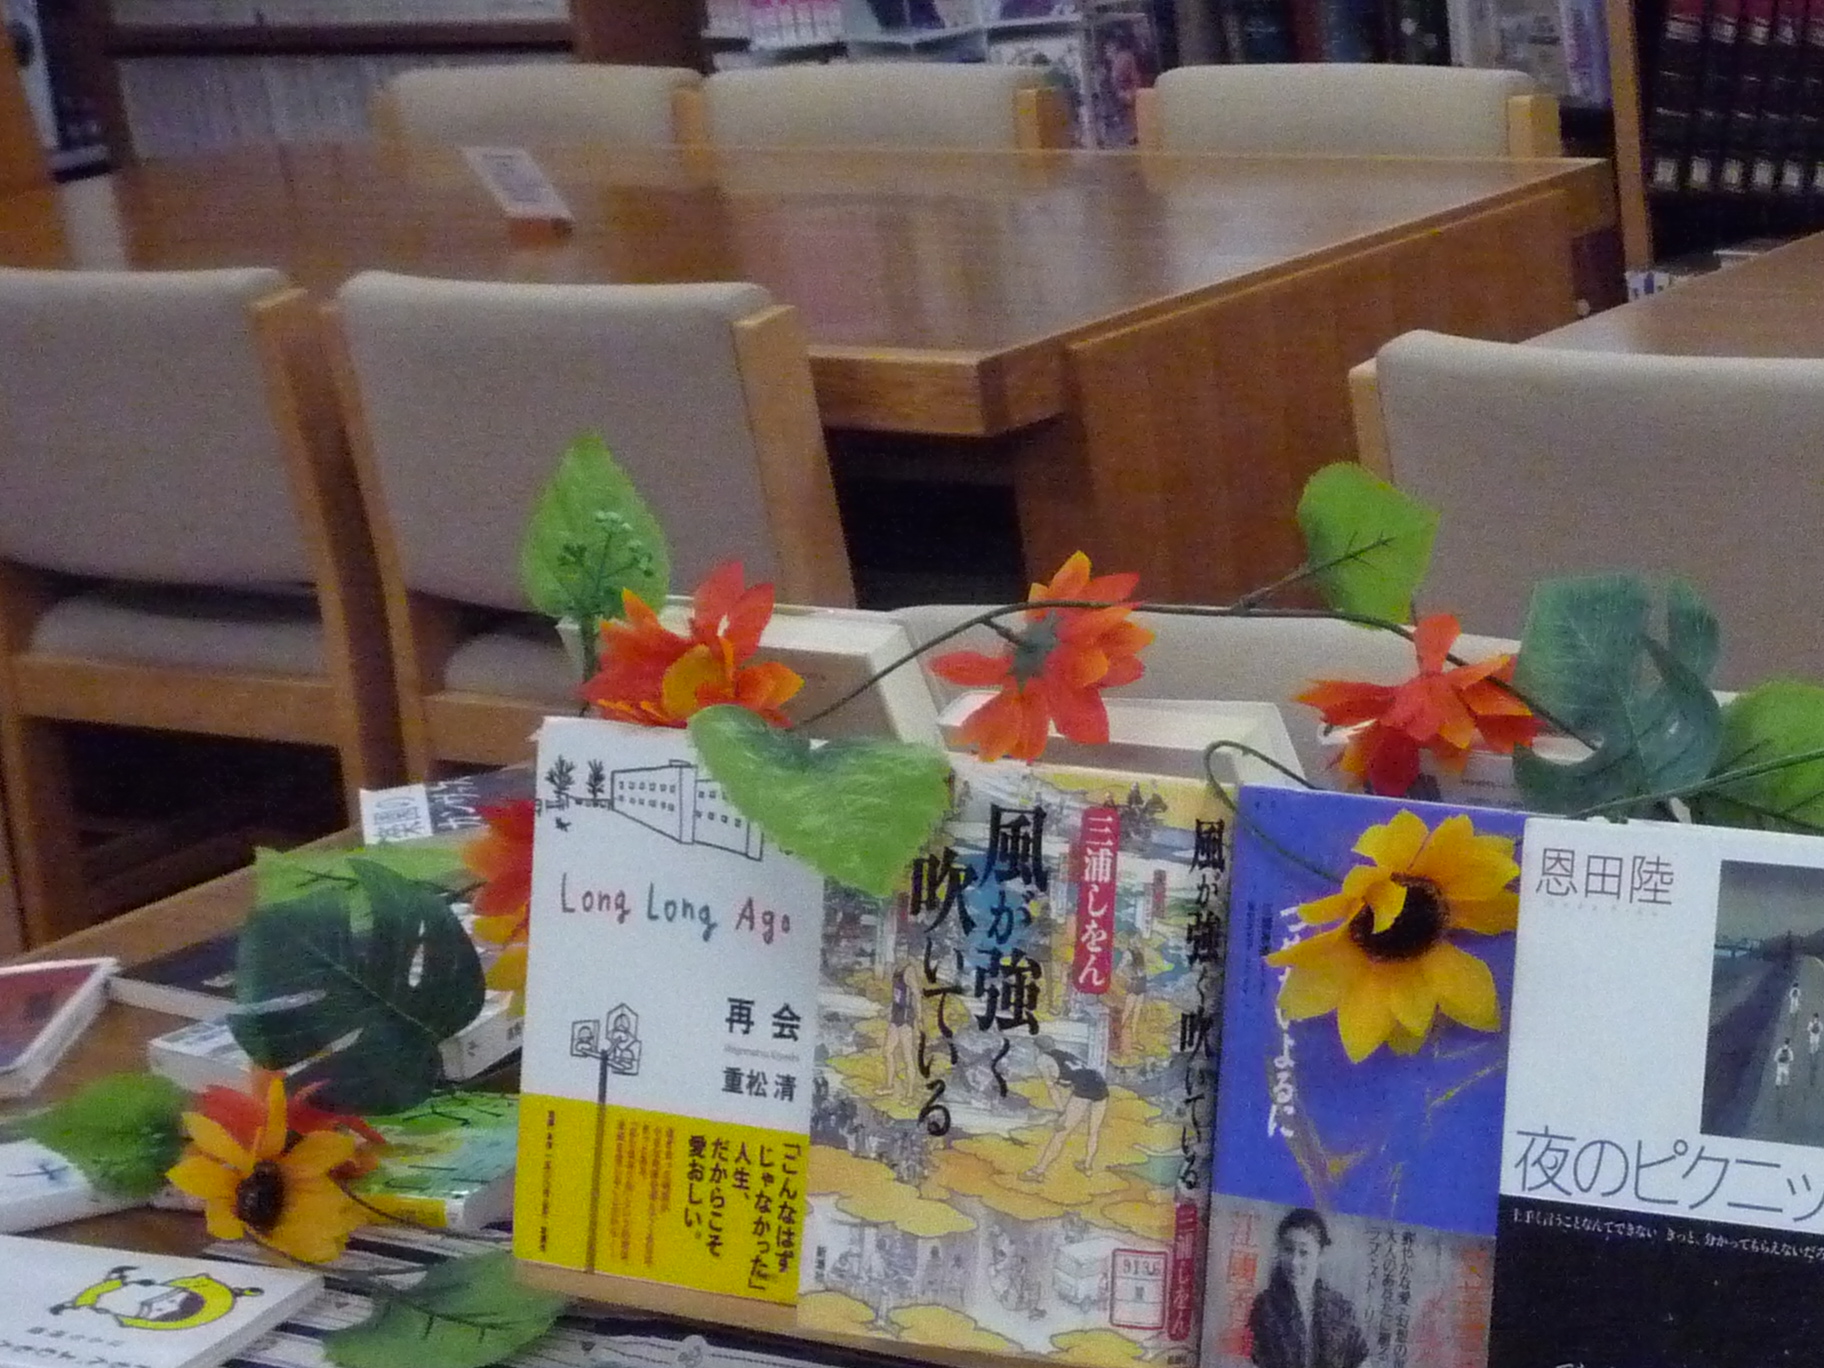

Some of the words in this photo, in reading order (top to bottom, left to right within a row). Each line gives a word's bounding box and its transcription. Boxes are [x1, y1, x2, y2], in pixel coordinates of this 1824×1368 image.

[560, 873, 633, 922] Long
[646, 880, 719, 942] Long
[735, 895, 791, 943] Ago
[1077, 815, 1116, 988] 三浦しをん
[1534, 846, 1675, 907] 恩田陸
[725, 997, 802, 1042] 再会
[910, 848, 978, 1138] 吹いている
[722, 1066, 797, 1102] 重松清
[706, 1137, 730, 1258] だからこそ
